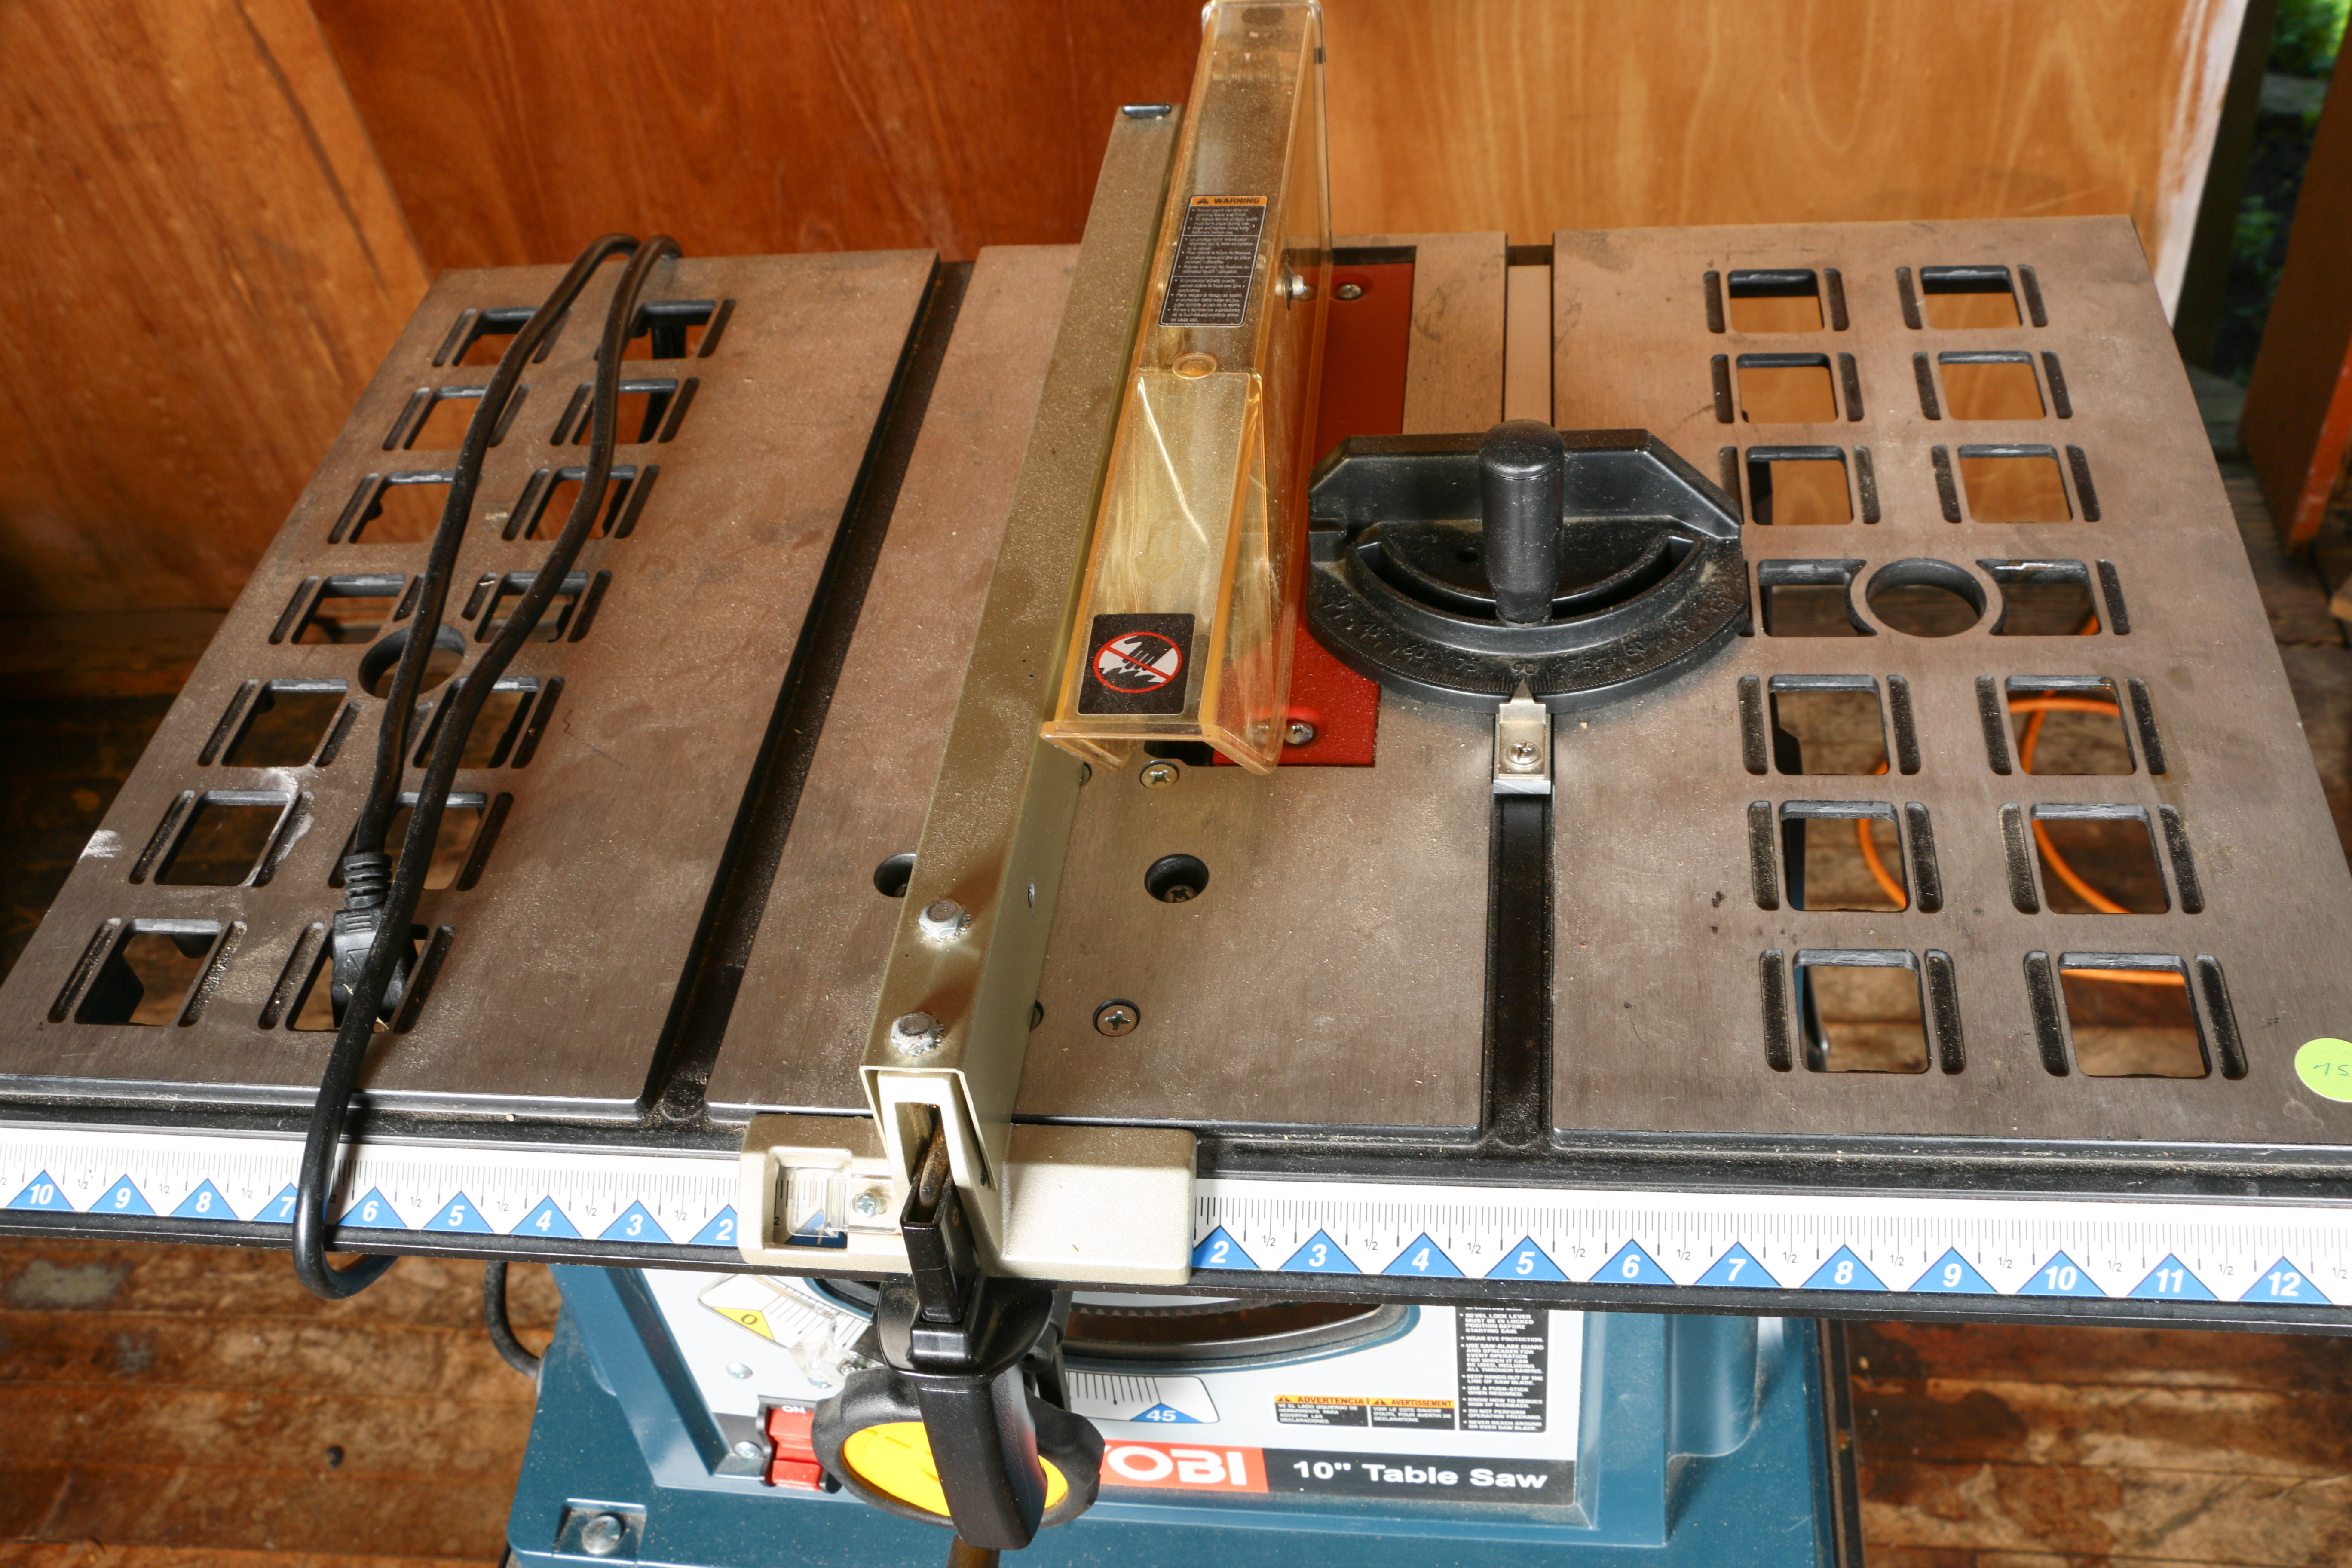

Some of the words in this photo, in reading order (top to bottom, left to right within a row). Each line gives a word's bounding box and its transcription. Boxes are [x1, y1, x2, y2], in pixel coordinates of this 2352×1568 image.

[1511, 662, 1538, 676] 90
[30, 1183, 54, 1205] 10
[115, 1187, 131, 1209] 9
[196, 1191, 212, 1213] 8
[280, 1196, 296, 1218] 7
[362, 1200, 379, 1222] 6
[448, 1204, 466, 1227] 5
[536, 1210, 552, 1232] 4
[626, 1213, 643, 1236] 3
[715, 1218, 734, 1241] 2
[1210, 1240, 1229, 1264] 2
[1308, 1243, 1328, 1267] 3
[1412, 1248, 1430, 1271] 4
[1516, 1251, 1536, 1274] 5
[1622, 1254, 1641, 1279] 6
[1727, 1258, 1747, 1282] 7
[1834, 1260, 1854, 1285] 8
[1942, 1262, 1962, 1289] 9
[2044, 1265, 2077, 1291] 10
[2155, 1268, 2184, 1294] 11
[2267, 1271, 2302, 1298] 12
[741, 1314, 758, 1325] 0
[782, 1405, 807, 1414] ON
[1146, 1410, 1176, 1422] 45
[1293, 1461, 1350, 1480] 10"
[1361, 1464, 1459, 1485] Table
[1470, 1468, 1547, 1489] Saw
